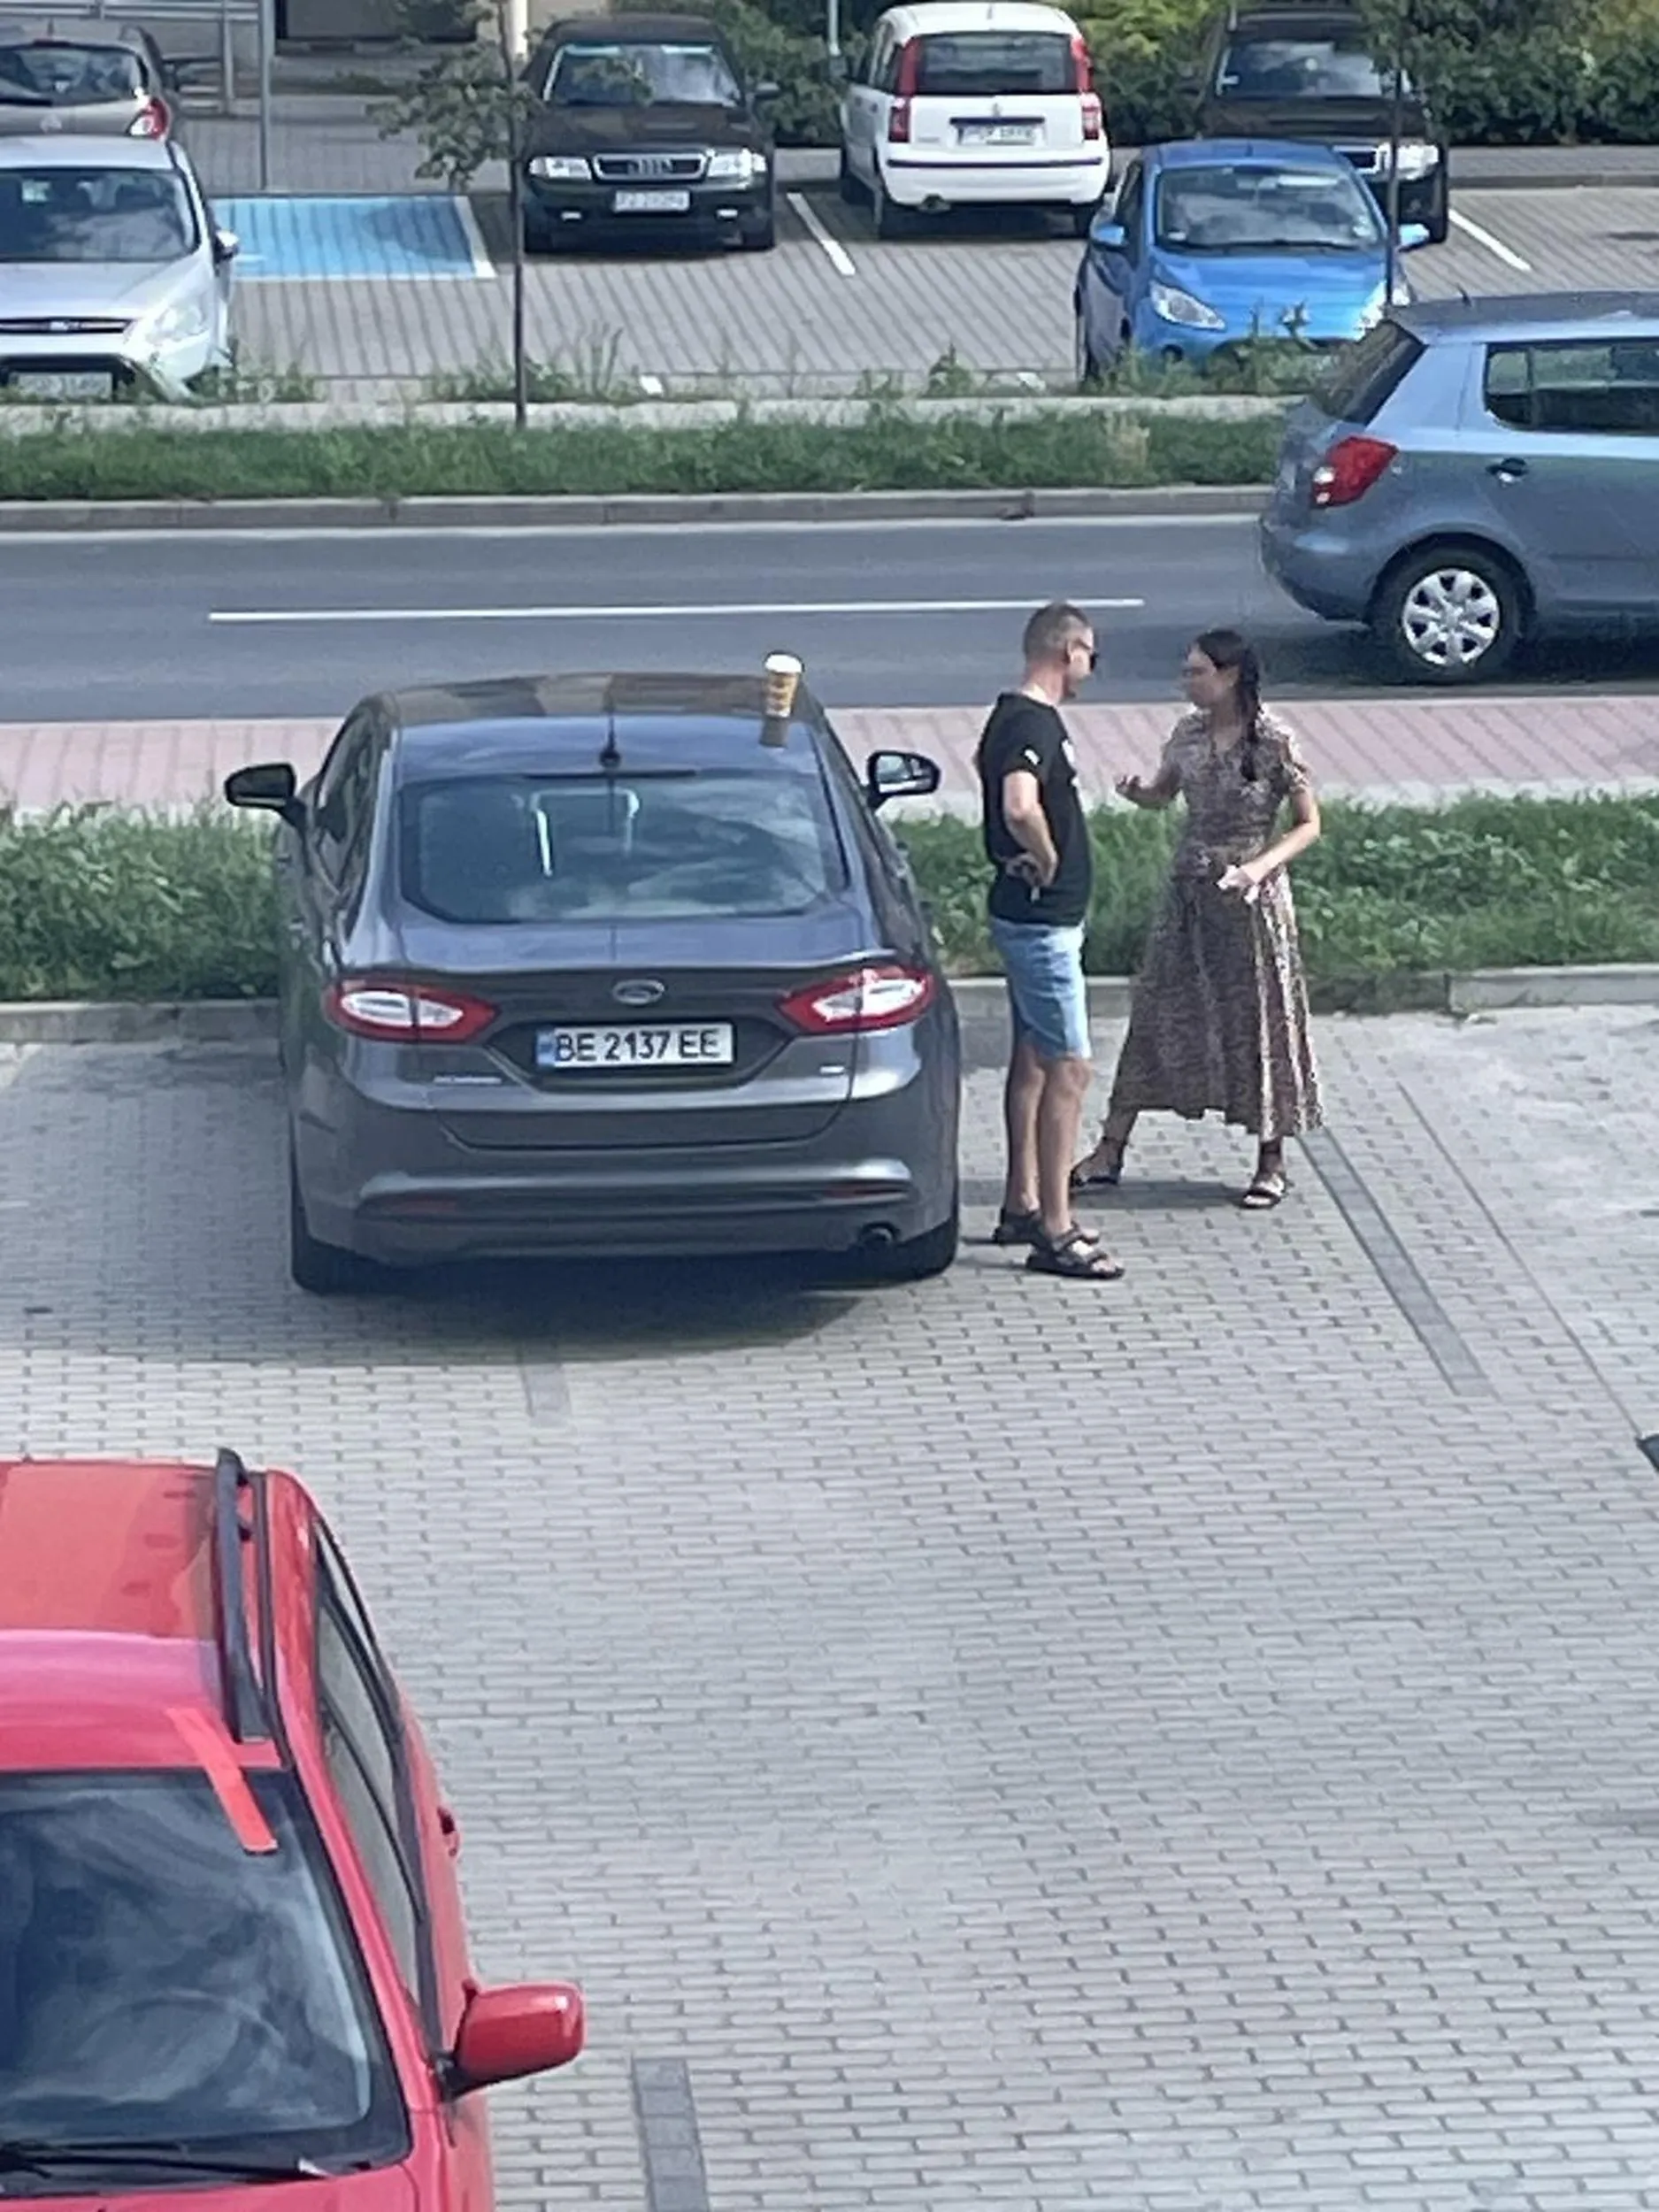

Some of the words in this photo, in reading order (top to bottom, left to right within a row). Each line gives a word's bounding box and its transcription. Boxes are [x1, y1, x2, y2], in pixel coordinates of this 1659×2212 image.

[556, 1033, 596, 1061] BE
[604, 1031, 670, 1060] 2137
[680, 1028, 720, 1057] EE
